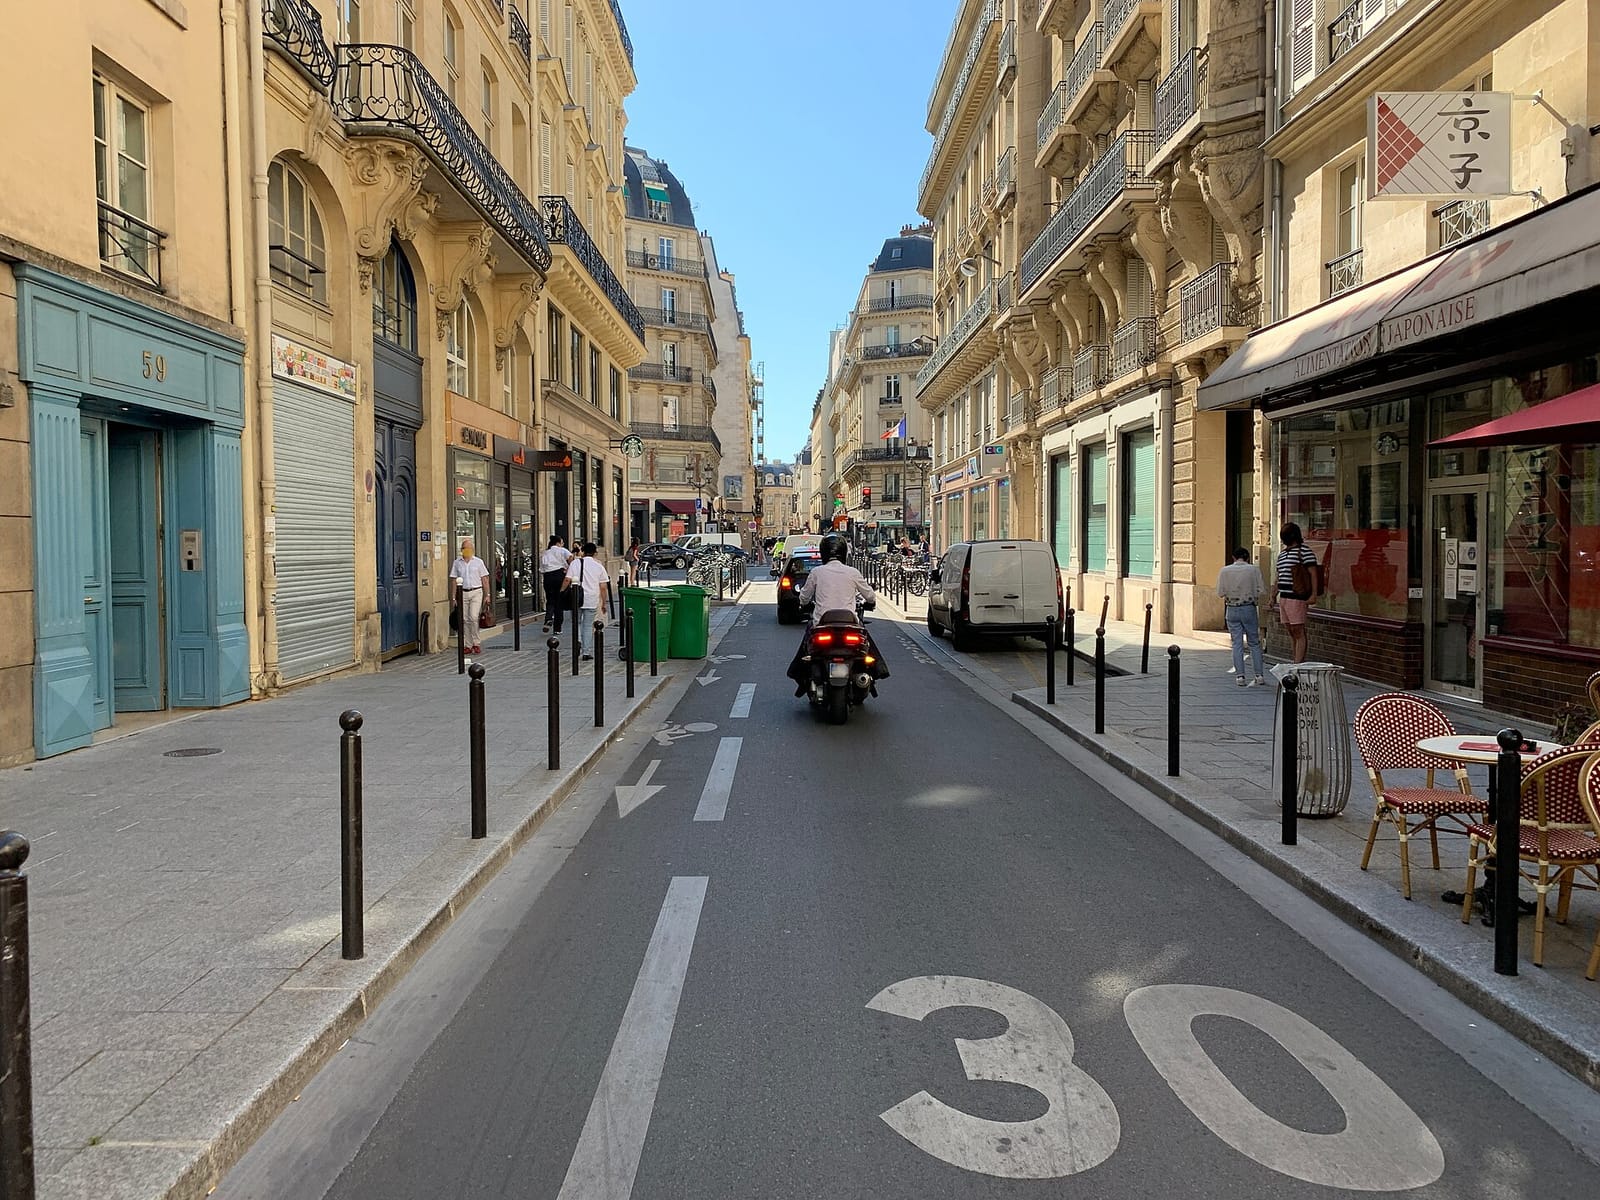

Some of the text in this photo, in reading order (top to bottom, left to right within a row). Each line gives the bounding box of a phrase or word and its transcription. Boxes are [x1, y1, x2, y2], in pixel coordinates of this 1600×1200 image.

[1437, 97, 1490, 190] 京子
[1387, 296, 1476, 346] JAPONAISE
[142, 350, 167, 382] 59
[986, 446, 1003, 454] CIC
[421, 532, 431, 541] 61
[864, 974, 1445, 1192] 30
